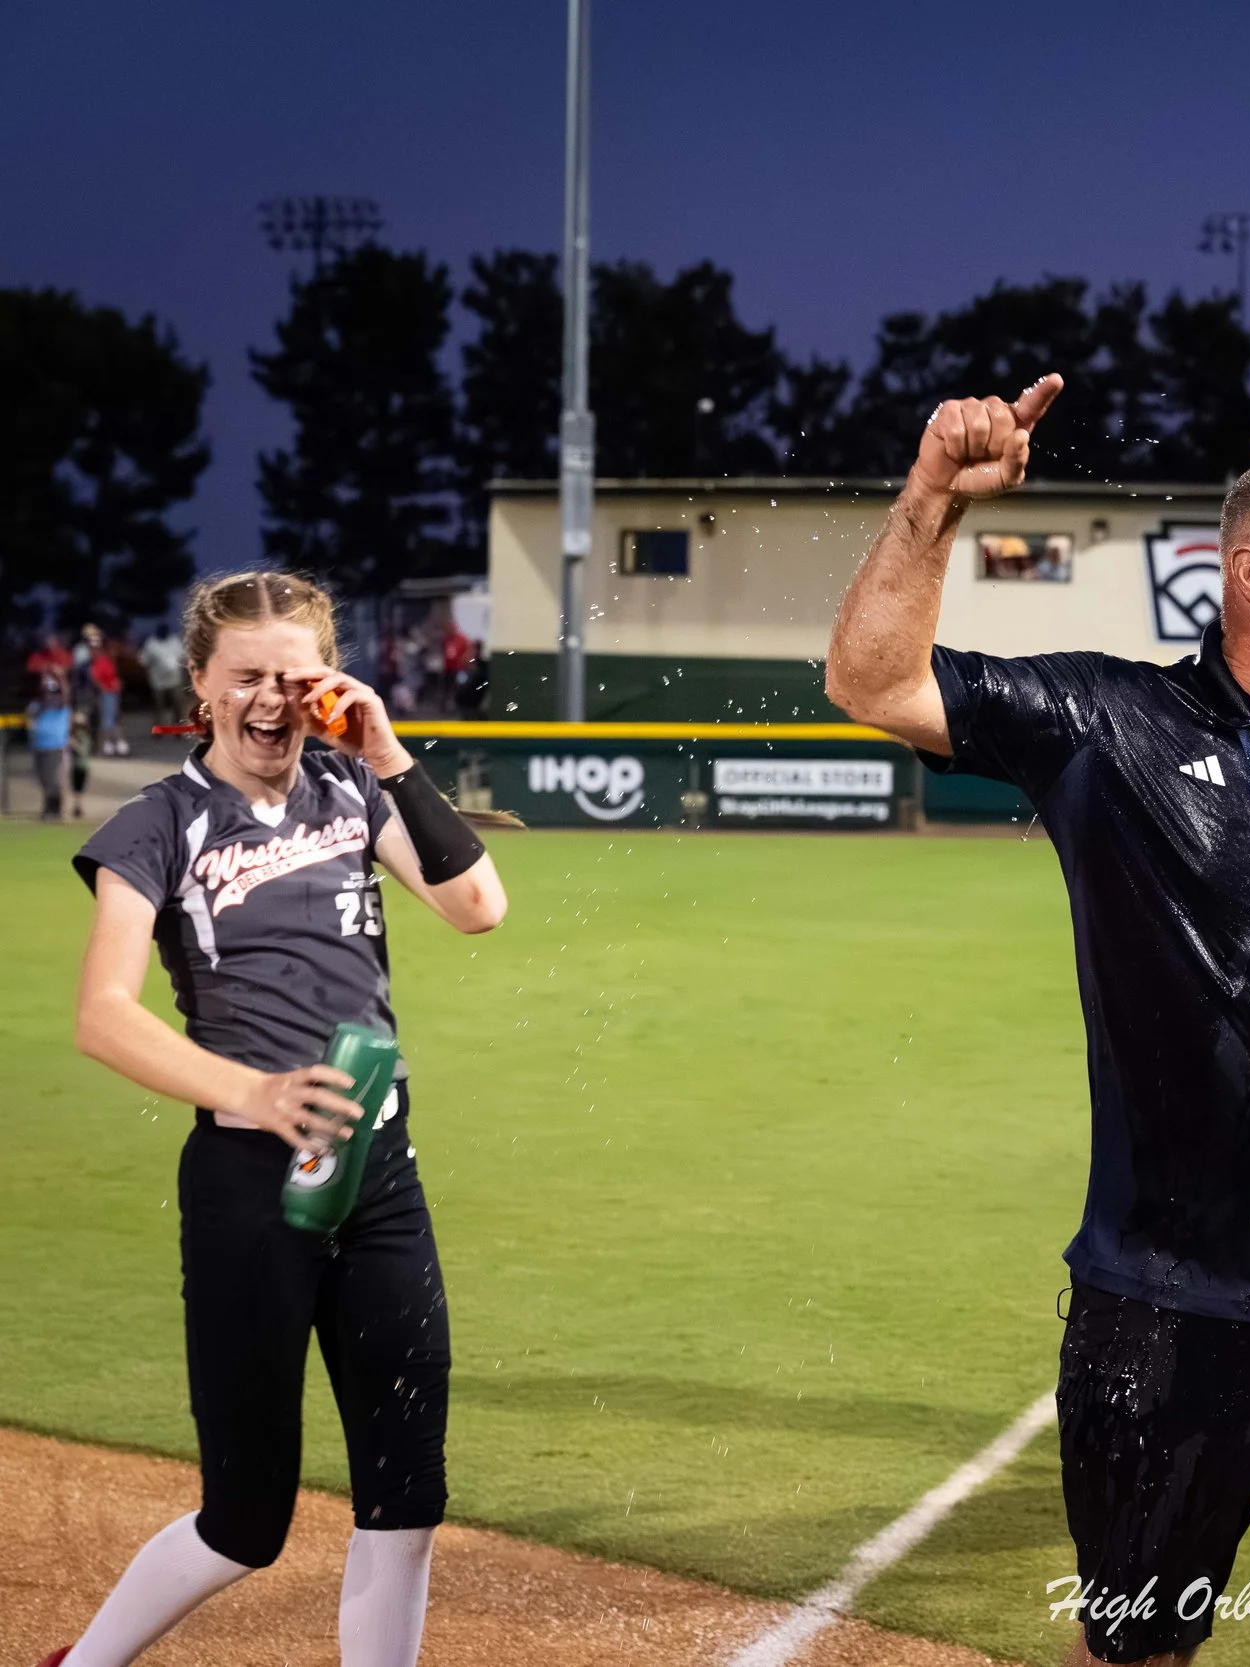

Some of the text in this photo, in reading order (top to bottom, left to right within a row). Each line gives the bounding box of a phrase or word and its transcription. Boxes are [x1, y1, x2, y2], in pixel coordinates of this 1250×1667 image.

[723, 769, 883, 786] OFFICIAL STORE
[195, 816, 369, 890] Westchester
[335, 892, 383, 936] 25
